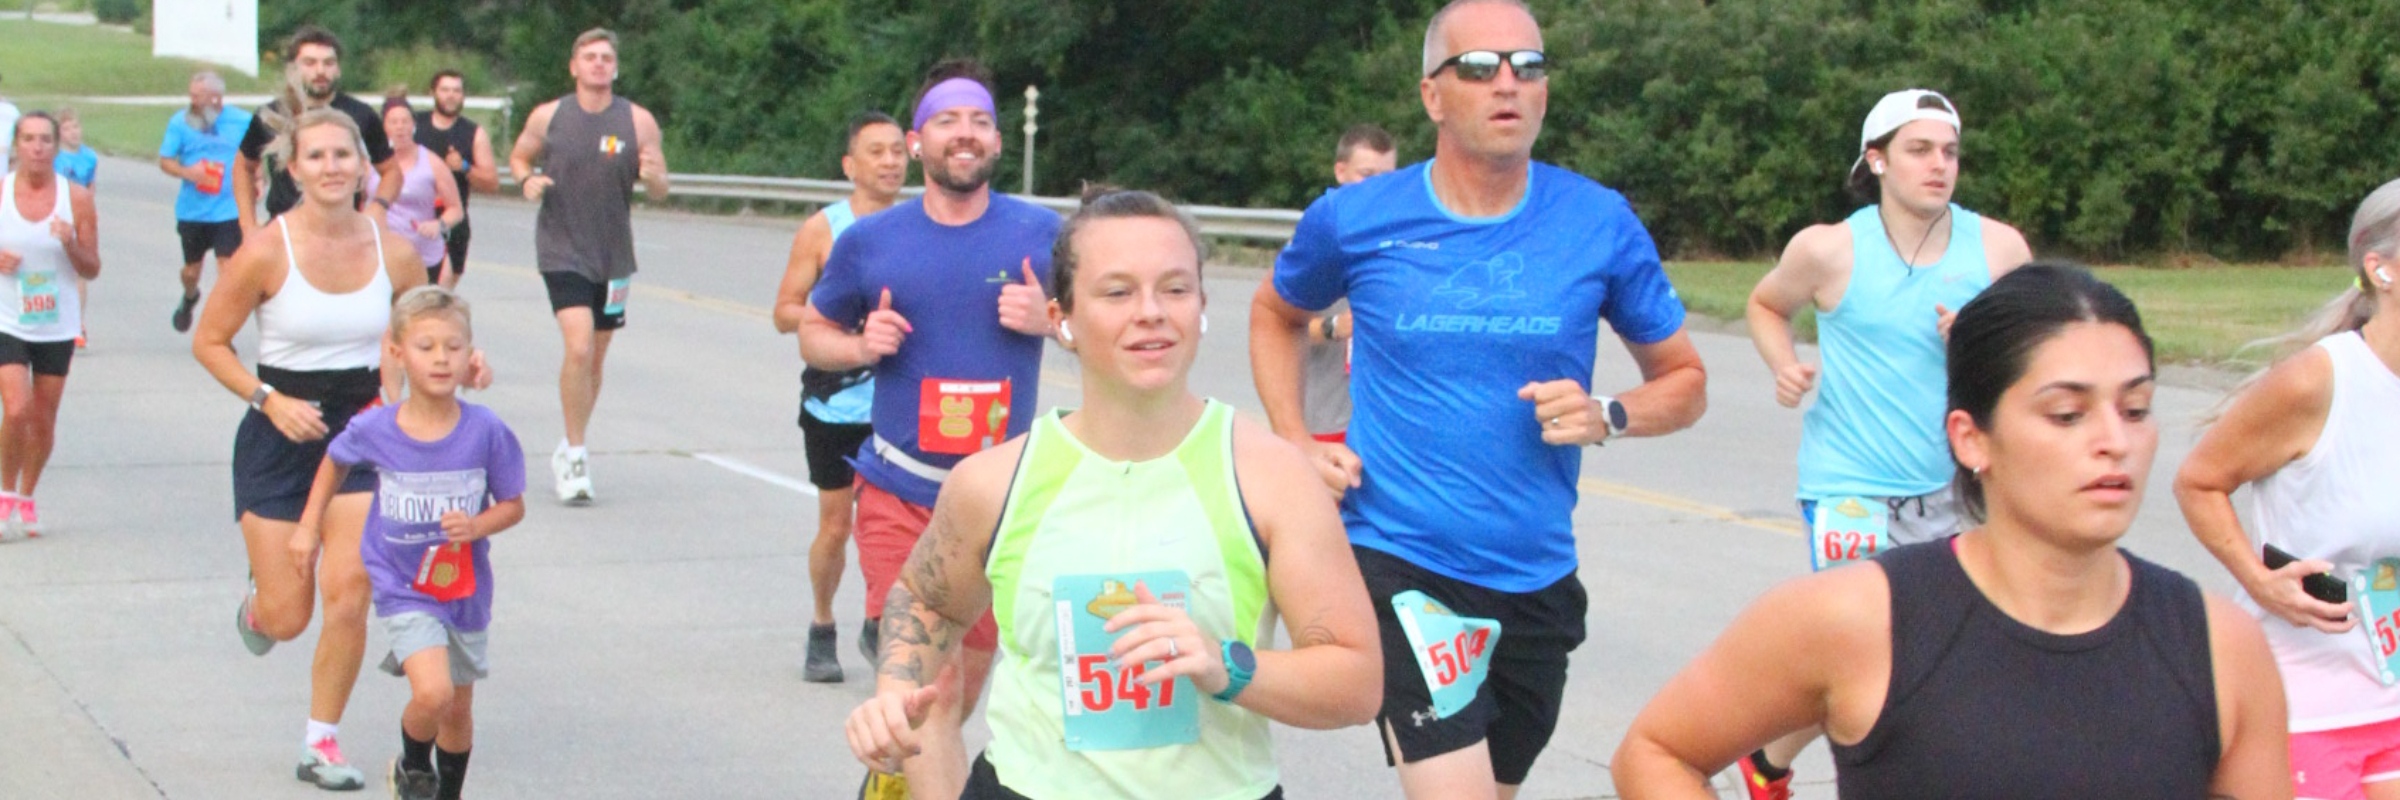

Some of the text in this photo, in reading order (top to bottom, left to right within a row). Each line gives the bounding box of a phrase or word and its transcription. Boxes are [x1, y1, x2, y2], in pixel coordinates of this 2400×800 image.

[1395, 312, 1562, 335] LAGERHEADS
[938, 394, 974, 438] 30
[1823, 530, 1877, 561] 621
[1428, 627, 1491, 686] 504
[1078, 653, 1175, 712] 547
